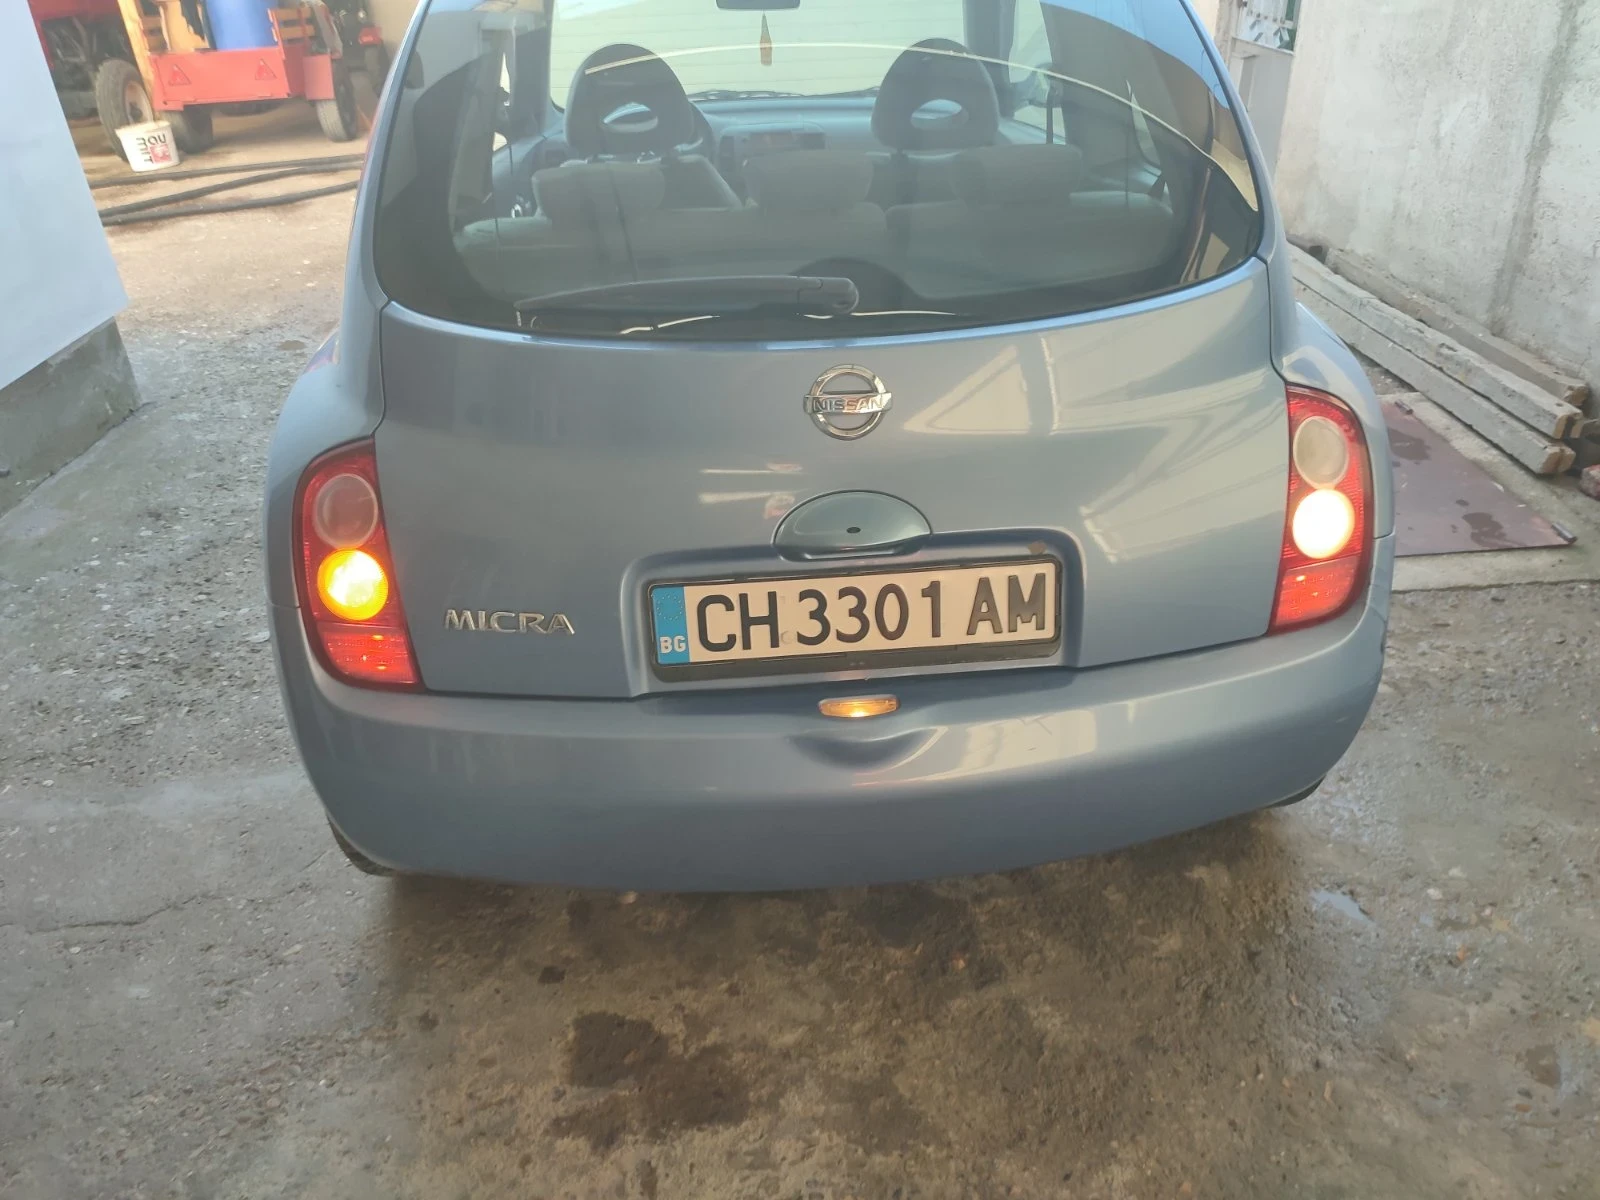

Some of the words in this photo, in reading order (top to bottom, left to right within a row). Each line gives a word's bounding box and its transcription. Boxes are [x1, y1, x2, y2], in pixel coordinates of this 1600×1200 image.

[813, 397, 883, 413] NISSAN
[444, 609, 575, 635] MICRA
[660, 635, 686, 654] BG
